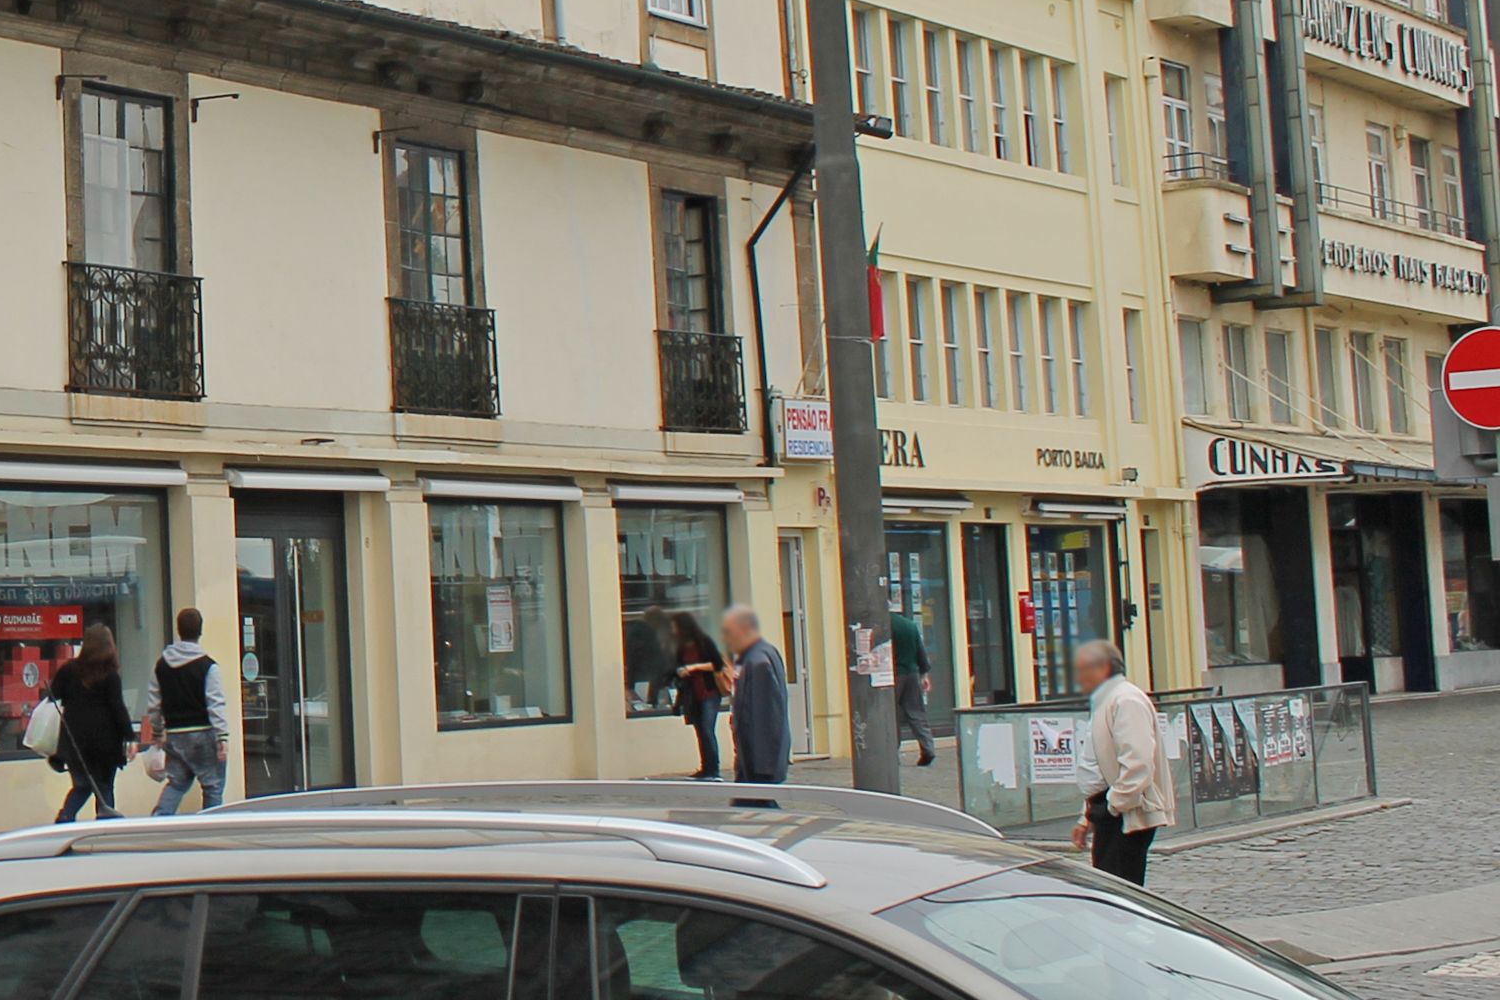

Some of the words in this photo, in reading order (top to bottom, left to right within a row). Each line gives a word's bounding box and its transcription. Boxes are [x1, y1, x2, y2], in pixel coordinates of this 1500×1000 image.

[1399, 23, 1474, 92] CUNHAS
[787, 403, 817, 430] PENSÃO
[1036, 448, 1072, 468] PORTO
[1074, 450, 1105, 469] BAIXA
[1209, 437, 1339, 476] CUNHAS
